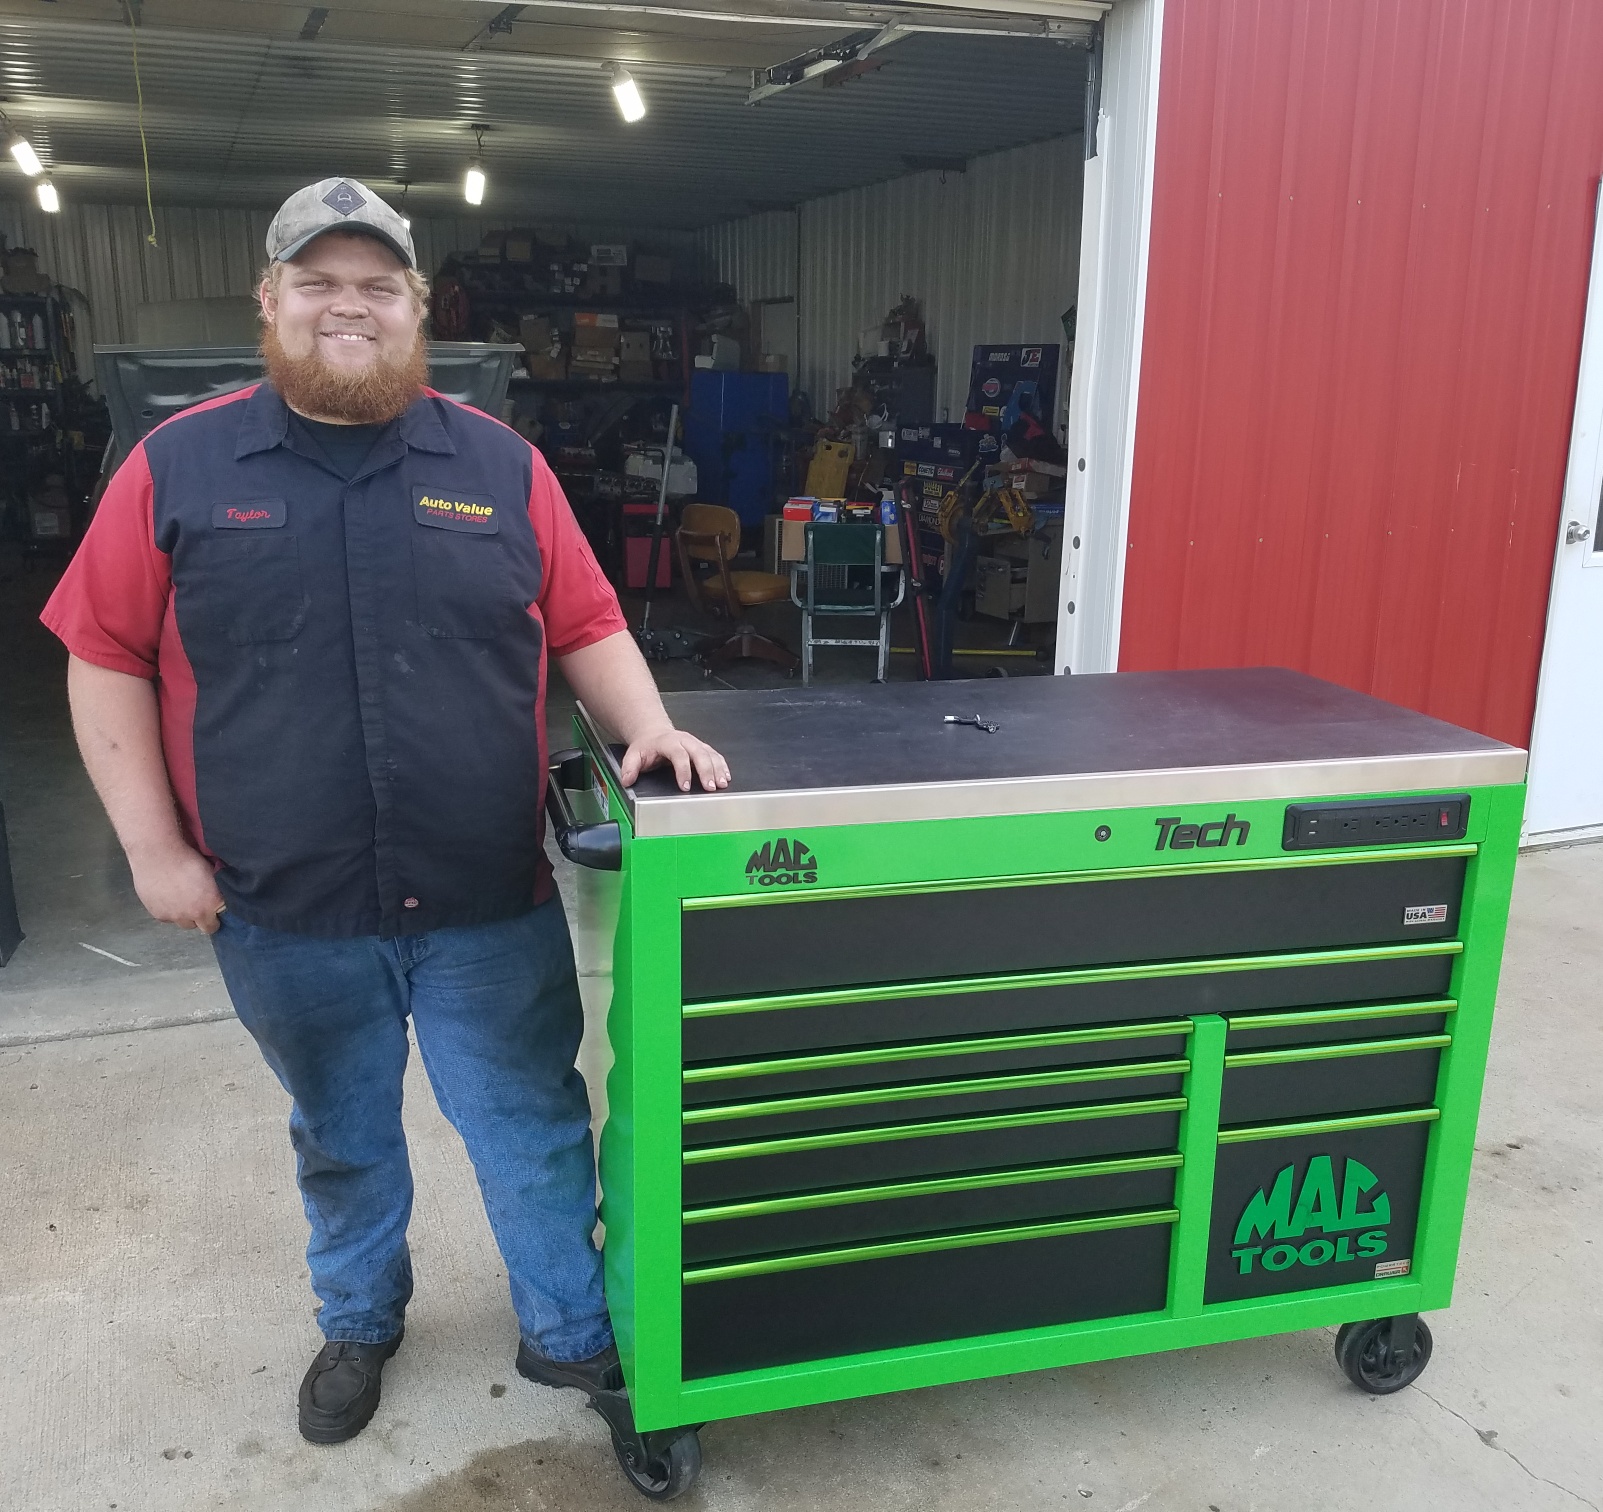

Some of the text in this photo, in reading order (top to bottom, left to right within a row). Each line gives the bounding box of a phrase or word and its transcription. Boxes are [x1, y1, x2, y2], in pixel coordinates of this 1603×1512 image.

[226, 508, 271, 523] Taylor
[419, 496, 493, 516] Auto Value
[427, 508, 488, 524] PARTS STORES
[1155, 813, 1251, 851] Tech
[745, 838, 818, 873] MAC
[745, 872, 818, 886] TOOLS
[1406, 911, 1427, 920] USA
[1233, 1155, 1391, 1245] MAC
[1231, 1230, 1388, 1275] TOOLS
